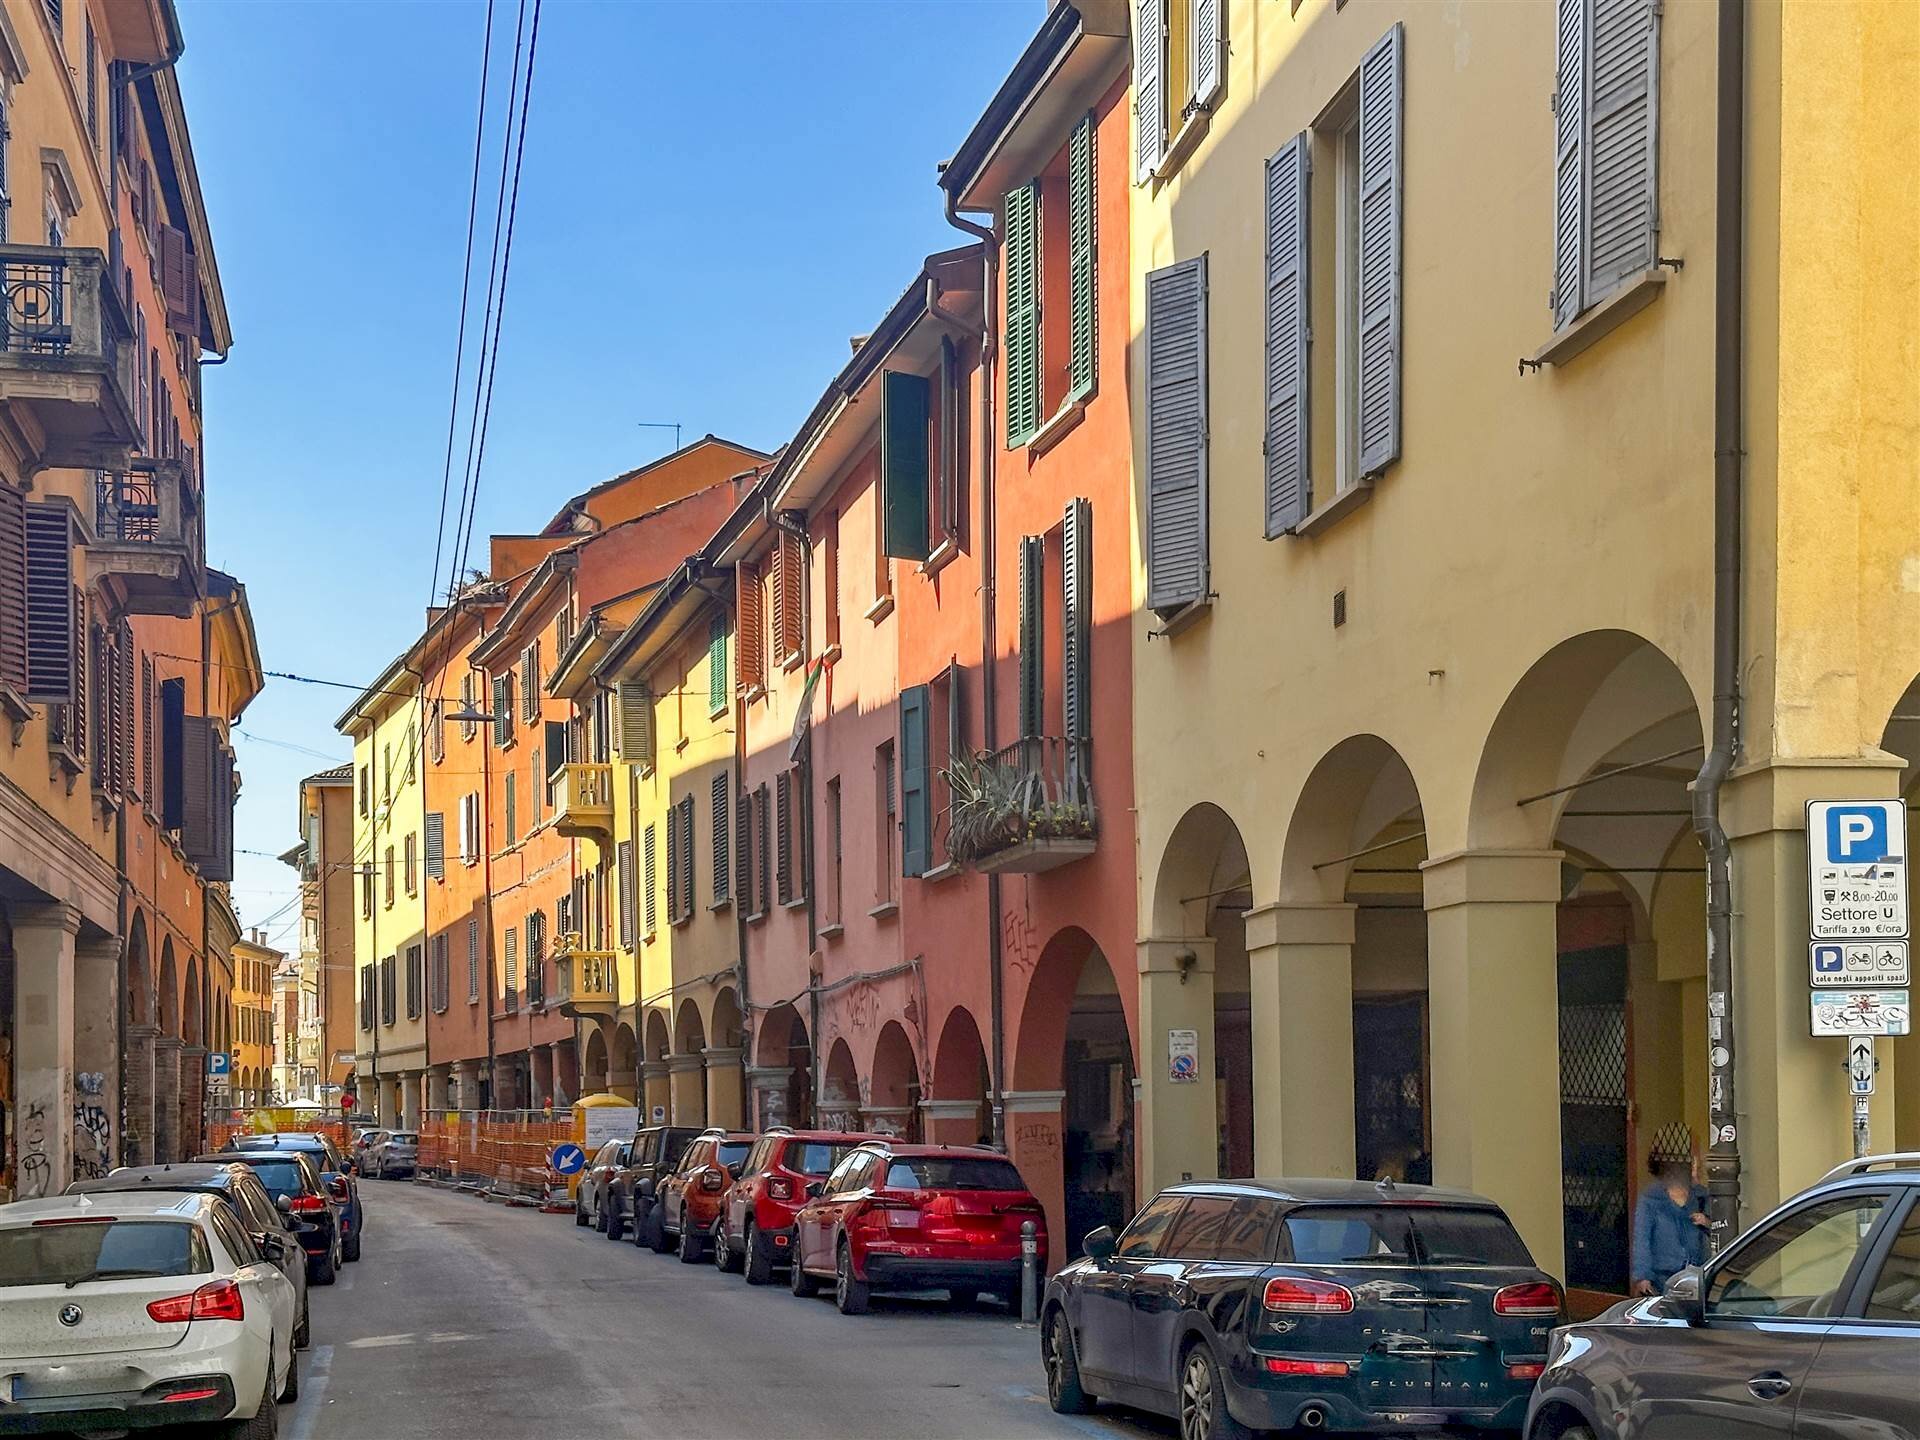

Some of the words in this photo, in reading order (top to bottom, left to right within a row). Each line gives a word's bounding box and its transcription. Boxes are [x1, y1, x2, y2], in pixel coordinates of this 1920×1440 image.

[1839, 814, 1874, 856] P
[1821, 907, 1878, 921] Settore
[1883, 907, 1893, 919] U
[1817, 924, 1848, 934] Tariffa
[1822, 950, 1838, 969] P
[1833, 974, 1852, 983] negli
[1854, 974, 1884, 983] appositi
[1886, 974, 1905, 982] spazi
[211, 1055, 225, 1073] P
[1370, 1380, 1489, 1389] CLUBMAN
